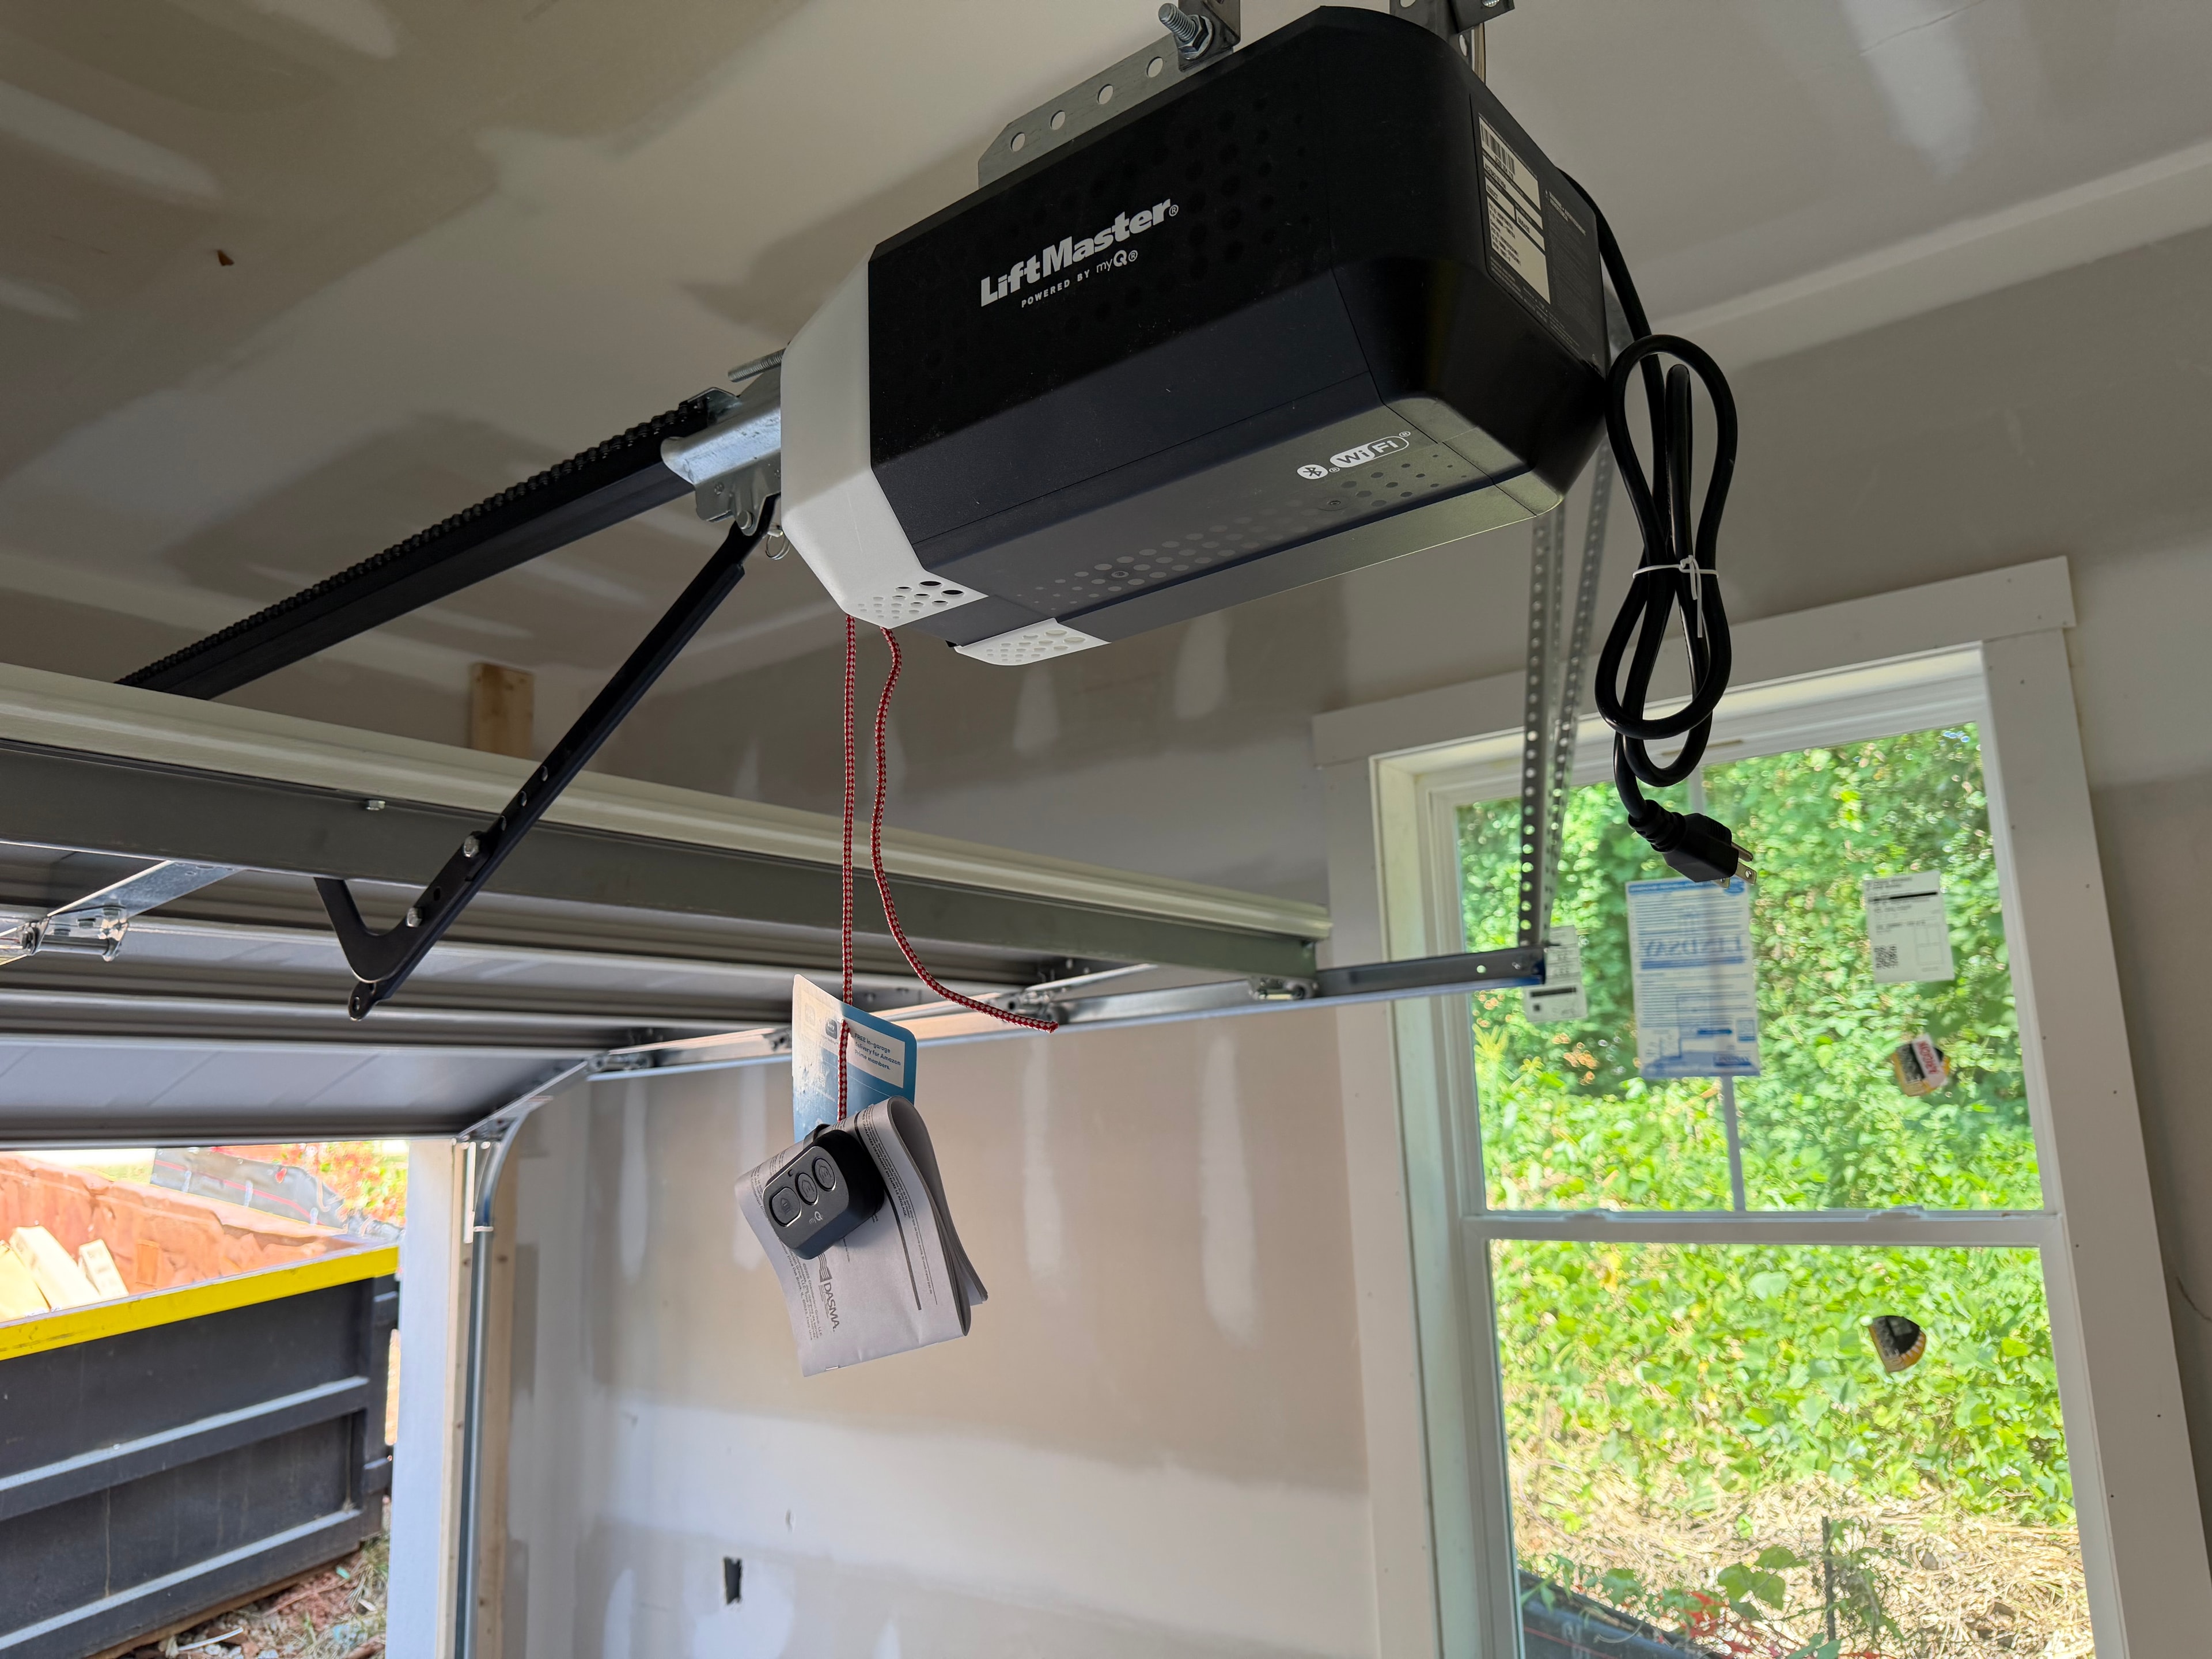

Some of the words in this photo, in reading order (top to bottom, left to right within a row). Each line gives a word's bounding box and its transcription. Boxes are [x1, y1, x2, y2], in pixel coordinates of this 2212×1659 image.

[1021, 279, 1070, 308] POWERED
[1077, 270, 1090, 282] BY
[855, 1033, 866, 1043] FREE
[855, 1041, 872, 1055] delivery
[880, 1054, 901, 1066] Amazon
[855, 1049, 867, 1059] Prime
[868, 1056, 891, 1070] members.
